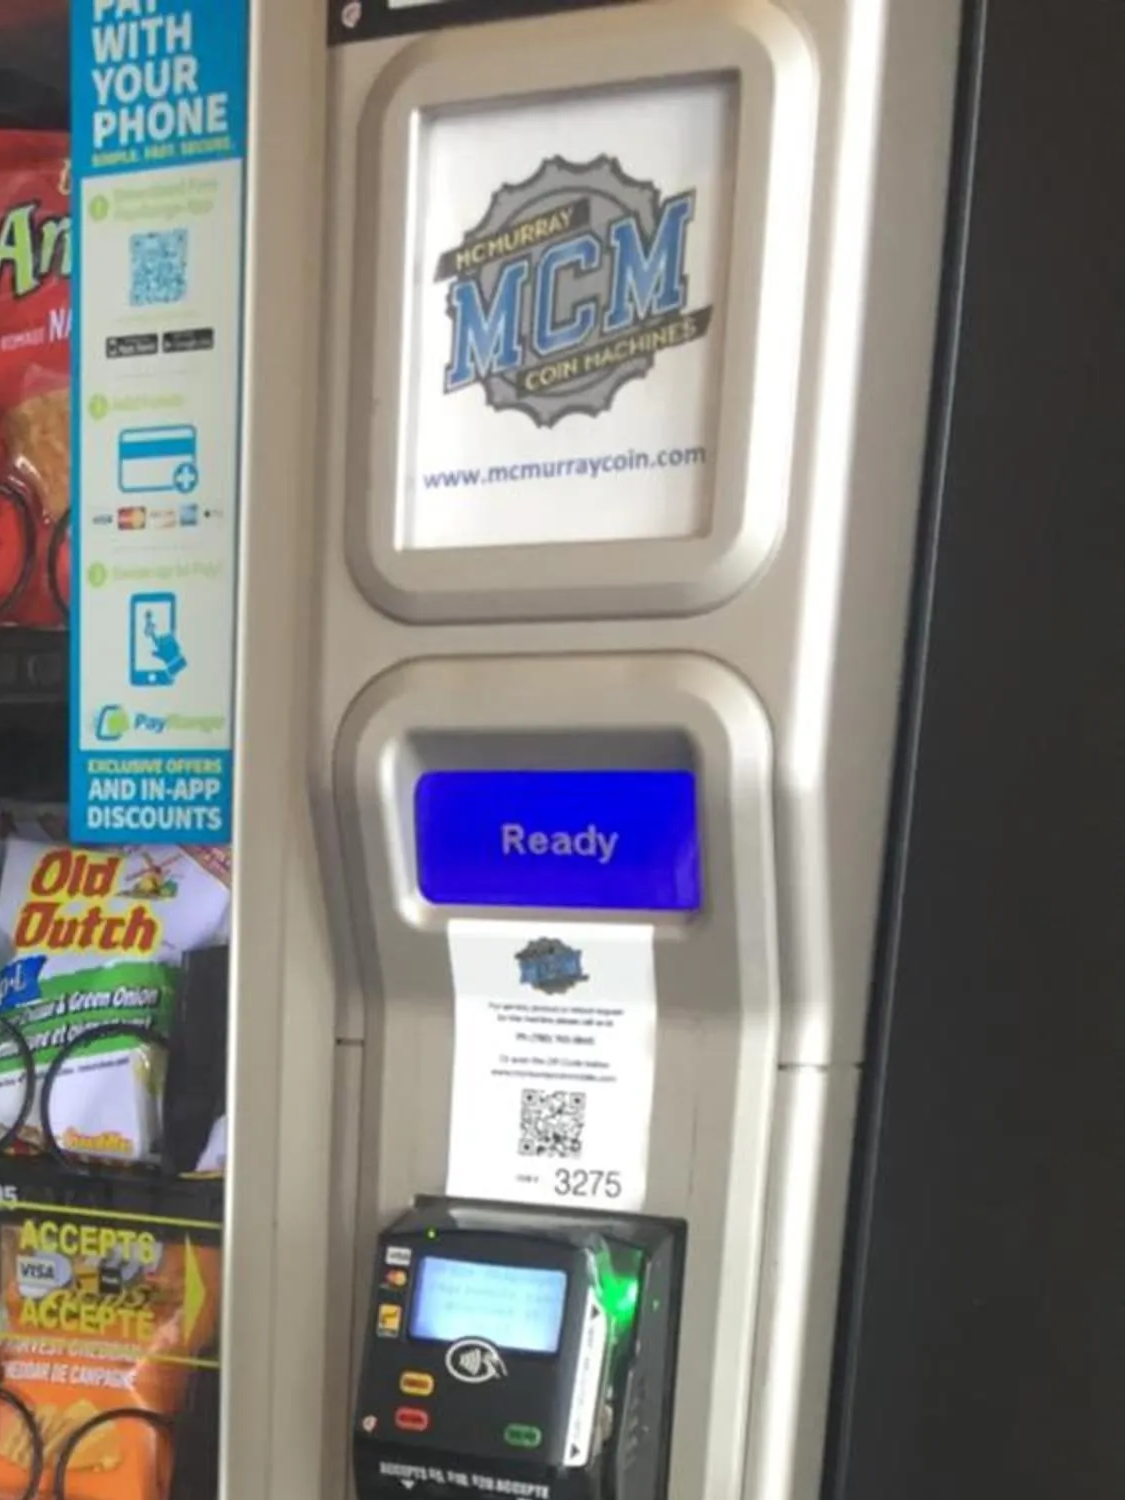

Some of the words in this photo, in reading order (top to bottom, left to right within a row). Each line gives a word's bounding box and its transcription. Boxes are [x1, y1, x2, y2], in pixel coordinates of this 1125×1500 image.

[91, 11, 192, 63] WITH
[91, 55, 198, 105] YOUR
[93, 93, 228, 148] PHONE
[455, 206, 573, 269] MCMURRAY
[445, 190, 696, 394] MCM
[524, 356, 578, 392] COIN
[584, 316, 697, 372] MACHINES
[424, 443, 707, 490] www.mcmurraycoin.com
[88, 778, 137, 801] AND
[141, 778, 221, 801] IN-APP
[87, 805, 223, 830] DISCOUNTS
[501, 823, 619, 863] Ready
[29, 850, 121, 899] Old
[13, 902, 157, 951] Dutch
[554, 1168, 622, 1198] 3275
[19, 1220, 156, 1264] ACCEPTS
[20, 1261, 54, 1280] VISA
[19, 1297, 155, 1340] ACCEPTE
